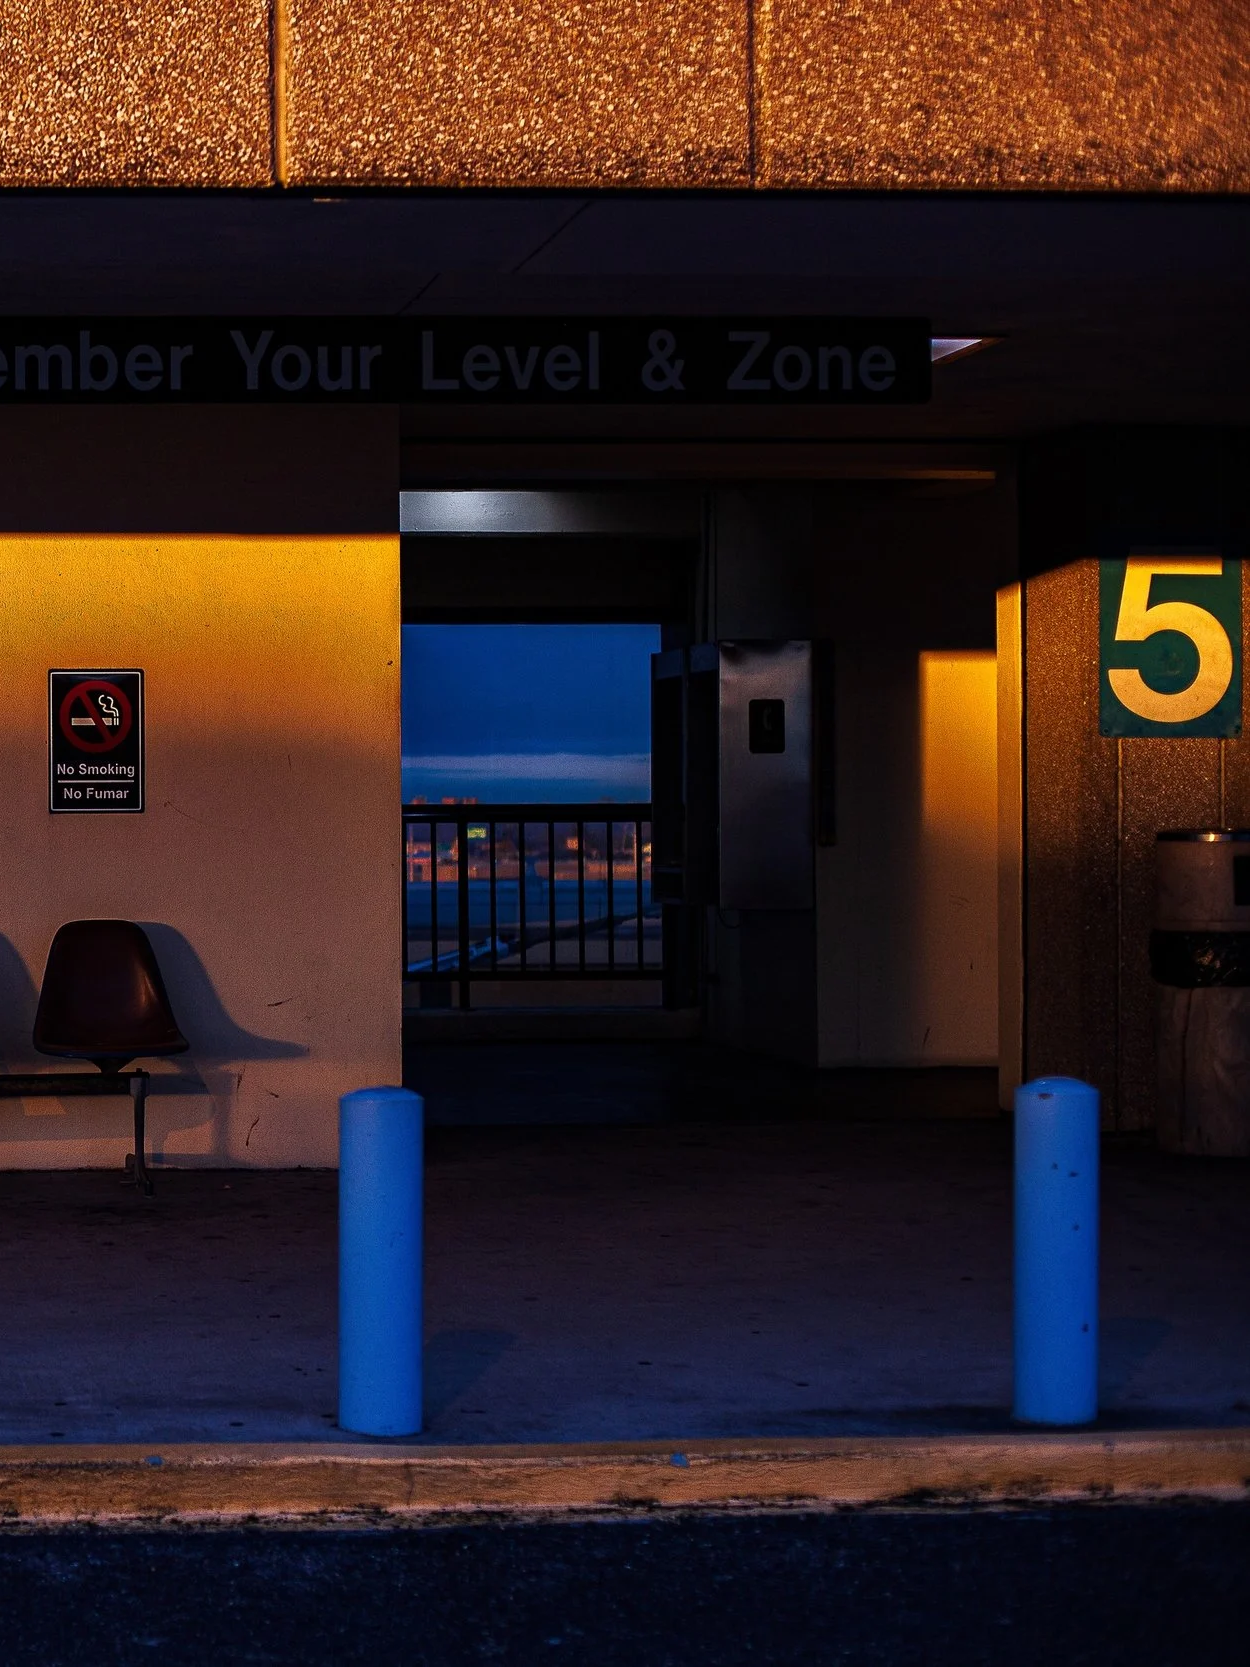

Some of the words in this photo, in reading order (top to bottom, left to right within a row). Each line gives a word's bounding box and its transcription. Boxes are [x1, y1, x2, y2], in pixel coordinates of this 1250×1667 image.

[229, 329, 383, 392] Your
[420, 329, 601, 392] Level
[641, 328, 686, 392] &
[726, 329, 897, 392] Zone
[1108, 546, 1234, 723] 5
[57, 763, 75, 776] No
[78, 763, 135, 778] Smoking
[63, 787, 83, 800] No
[86, 787, 130, 800] Fumar
